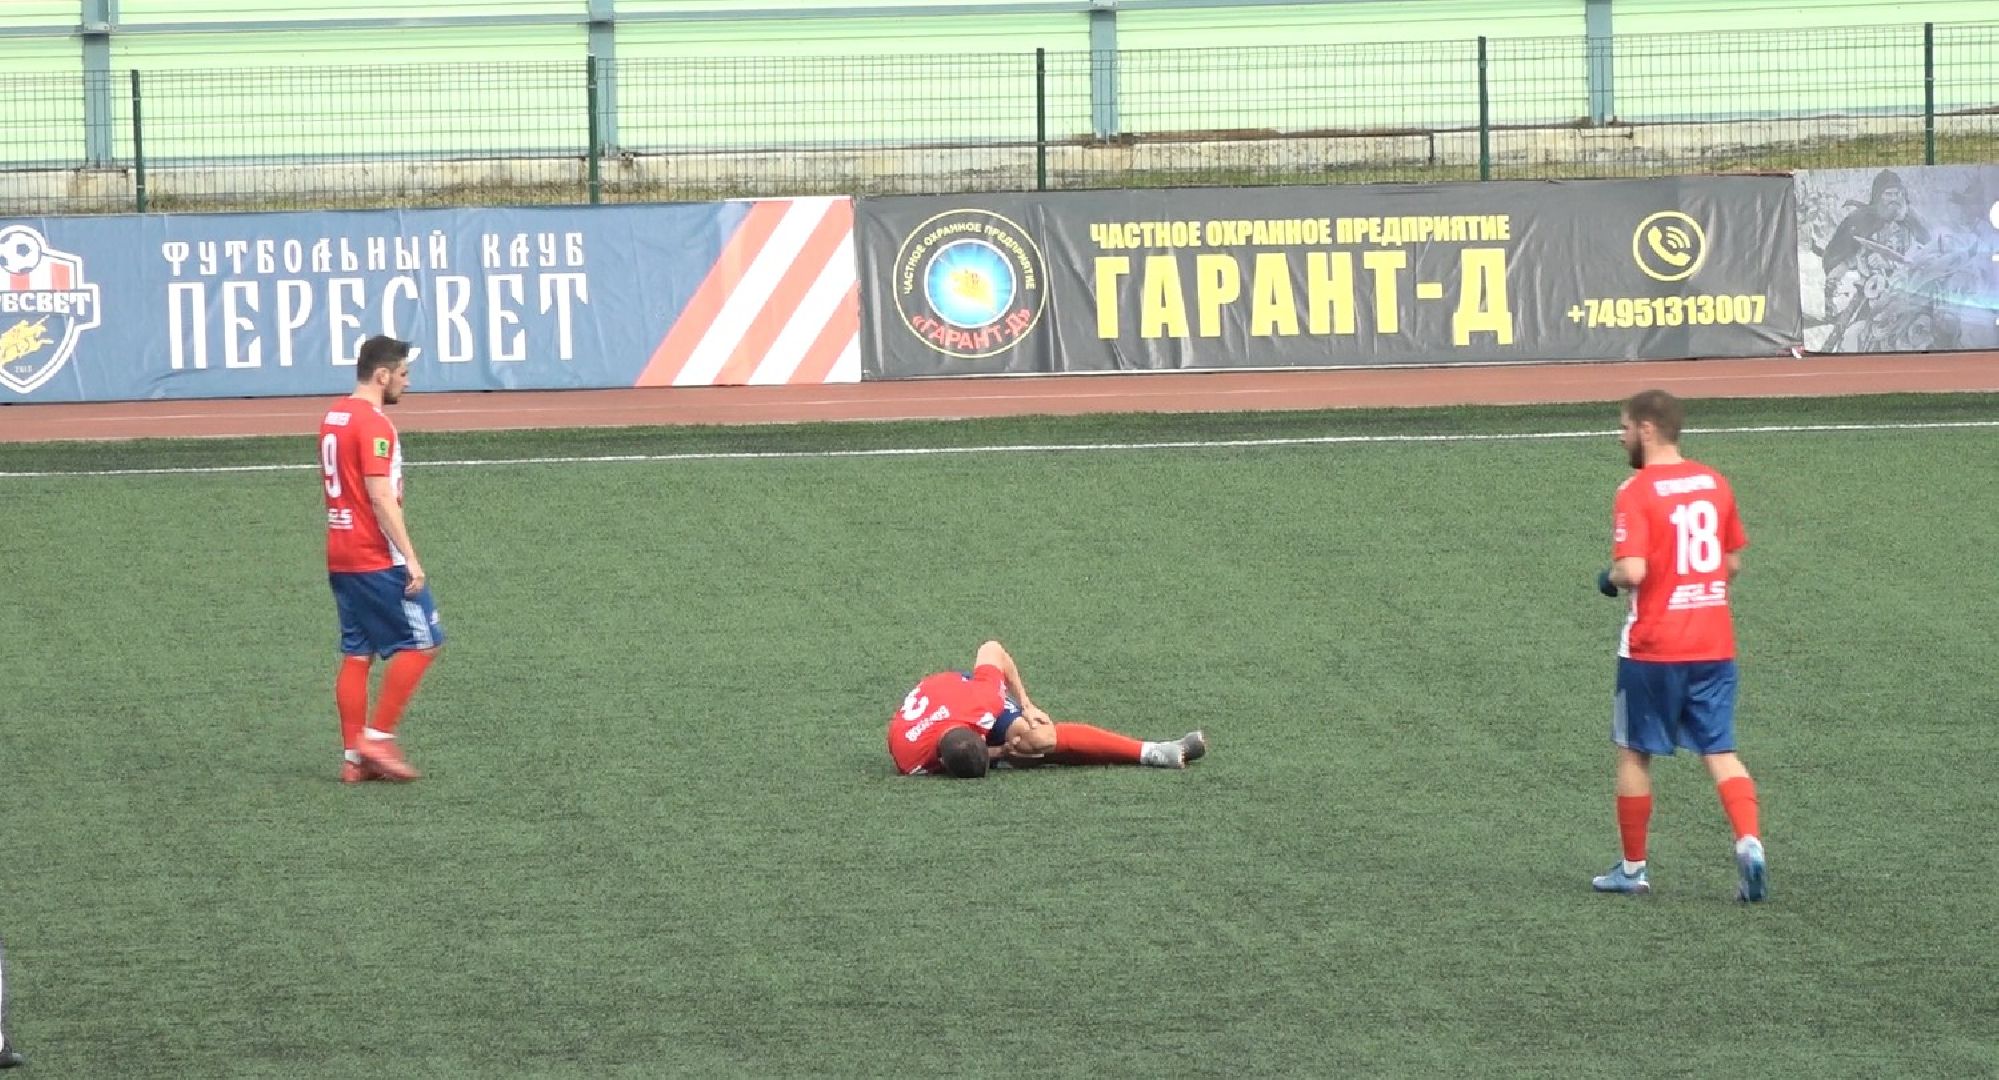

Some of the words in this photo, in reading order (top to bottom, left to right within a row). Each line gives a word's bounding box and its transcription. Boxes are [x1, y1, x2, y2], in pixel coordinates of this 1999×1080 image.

[161, 229, 448, 276] ФУТБОЛЬНЫЙ
[482, 232, 584, 269] КЛУБ
[904, 244, 926, 295] ЧАСТНОЕ
[924, 221, 982, 246] ОХРАННОЕ
[984, 224, 1036, 290] ПРЕДПРИЯТИЕ
[1090, 220, 1201, 249] ЧАСТНОЕ
[1205, 217, 1332, 247] ОХРАННОЕ
[1336, 215, 1511, 248] ПРЕДПРИЯТИЕ
[0, 291, 91, 317] ЕСВЕТ
[168, 272, 589, 370] ПЕРЕСВЕТ
[1094, 247, 1513, 346] ГАРАНТ-Д
[1567, 294, 1766, 328] +74951313007
[322, 433, 342, 498] 9
[1669, 500, 1722, 575] 18
